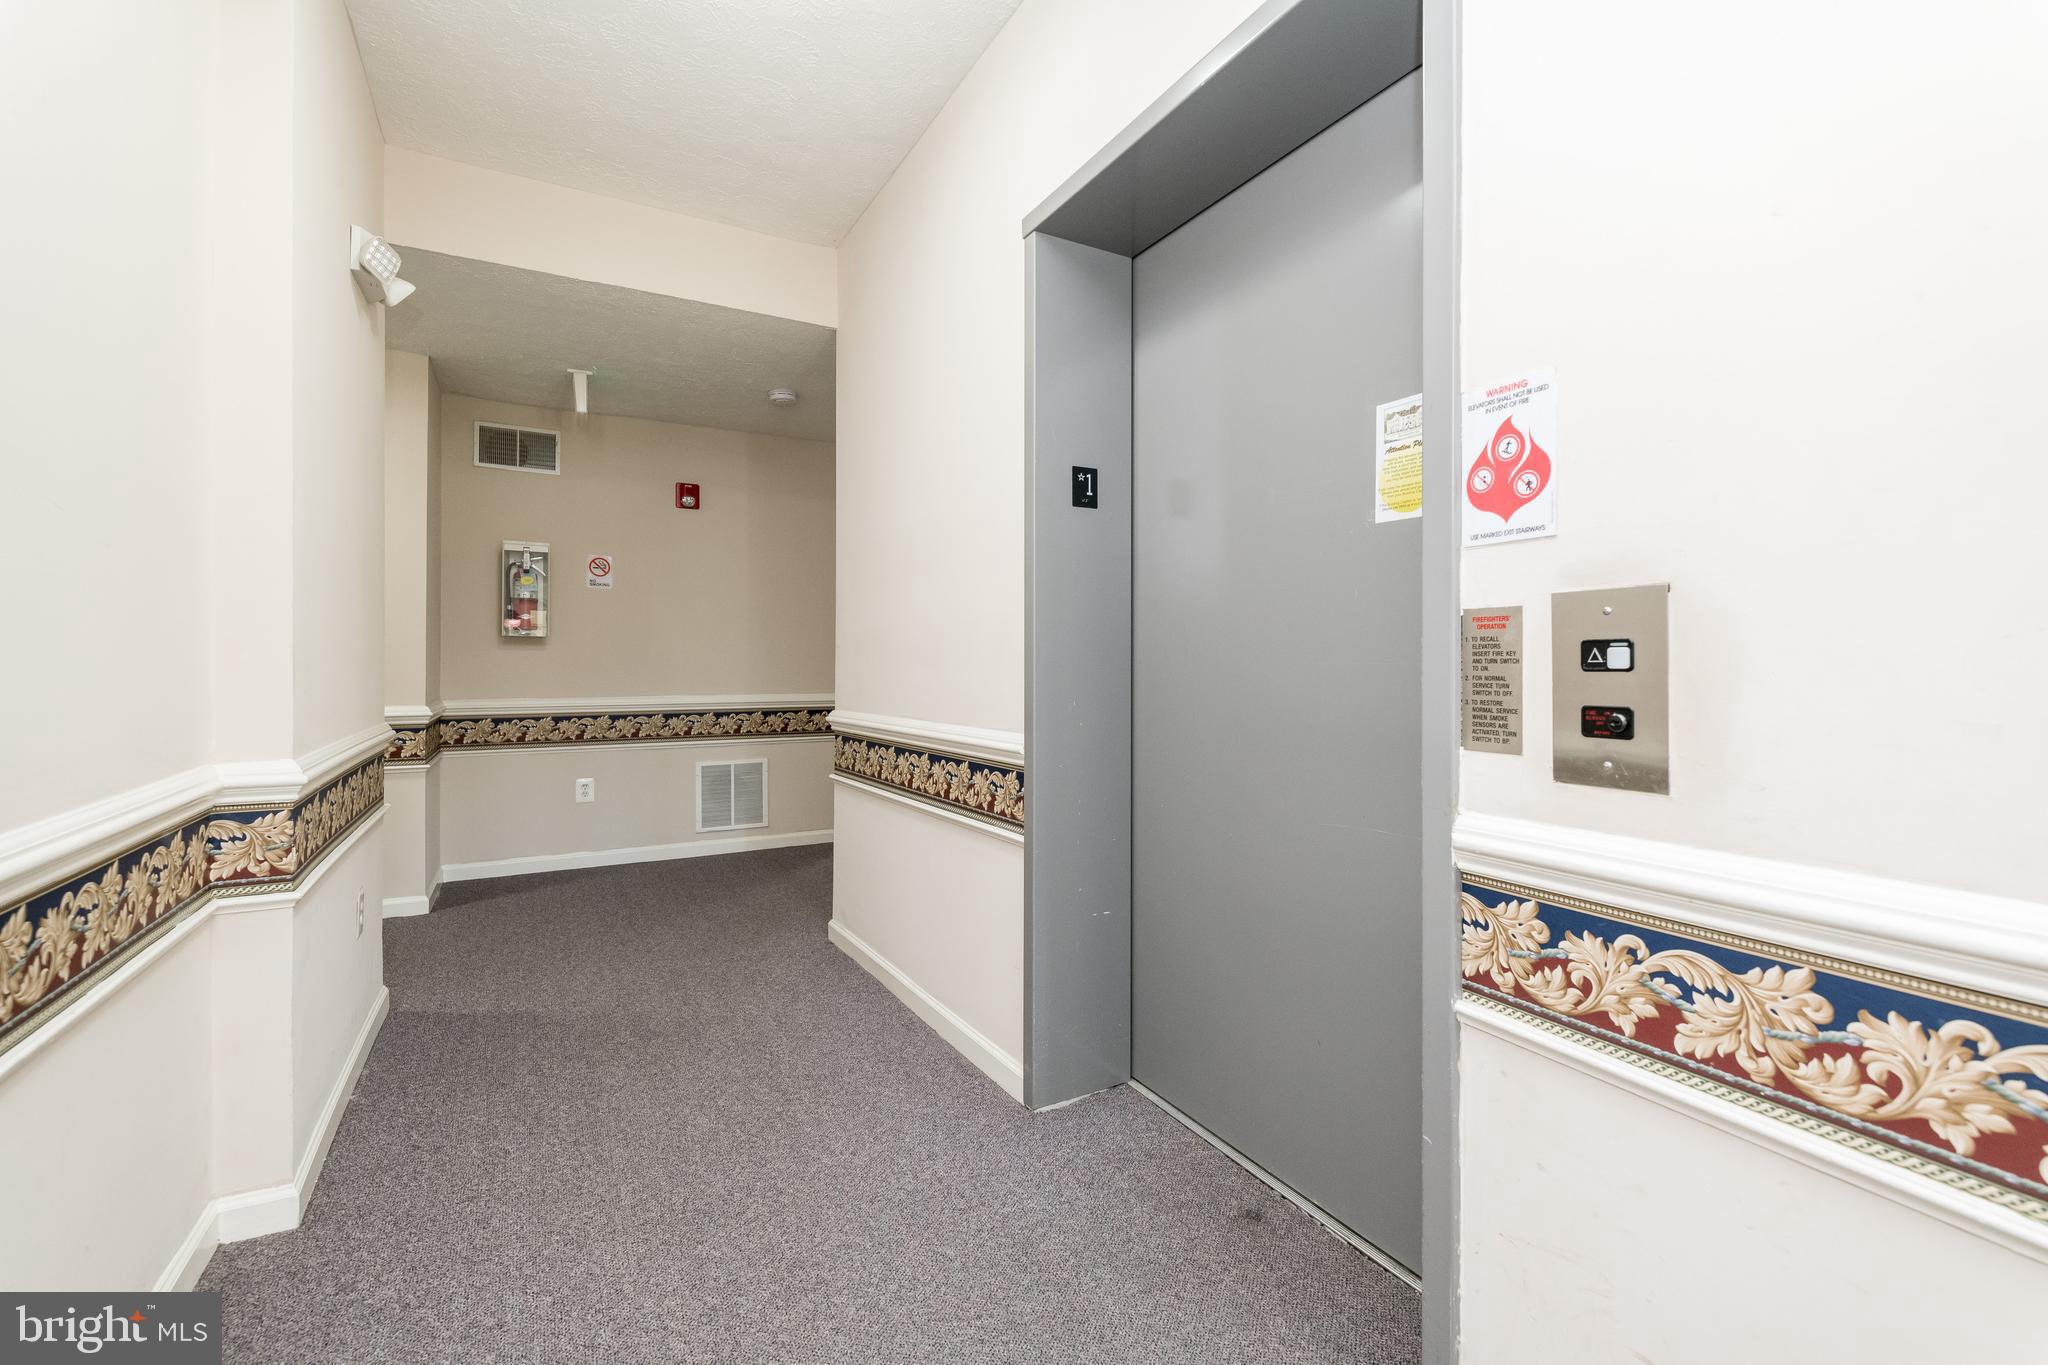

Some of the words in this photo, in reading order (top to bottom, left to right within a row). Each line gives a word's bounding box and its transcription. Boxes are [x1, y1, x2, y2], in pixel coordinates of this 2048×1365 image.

[1486, 379, 1529, 398] WARNING
[1468, 399, 1496, 412] ELEVATORS
[1496, 394, 1512, 403] SHALL
[1512, 390, 1526, 399] NOT
[1526, 387, 1533, 395] BE
[1533, 383, 1550, 393] USED
[1492, 403, 1508, 413] EVENT
[1385, 444, 1412, 455] Attention
[1470, 533, 1480, 541] USE
[1480, 530, 1504, 540] MARKED
[1503, 528, 1515, 537] EXIT
[1515, 524, 1546, 535] STAIRWAYS
[1495, 707, 1518, 715] SERVICE
[1489, 714, 1508, 722] SMOKE
